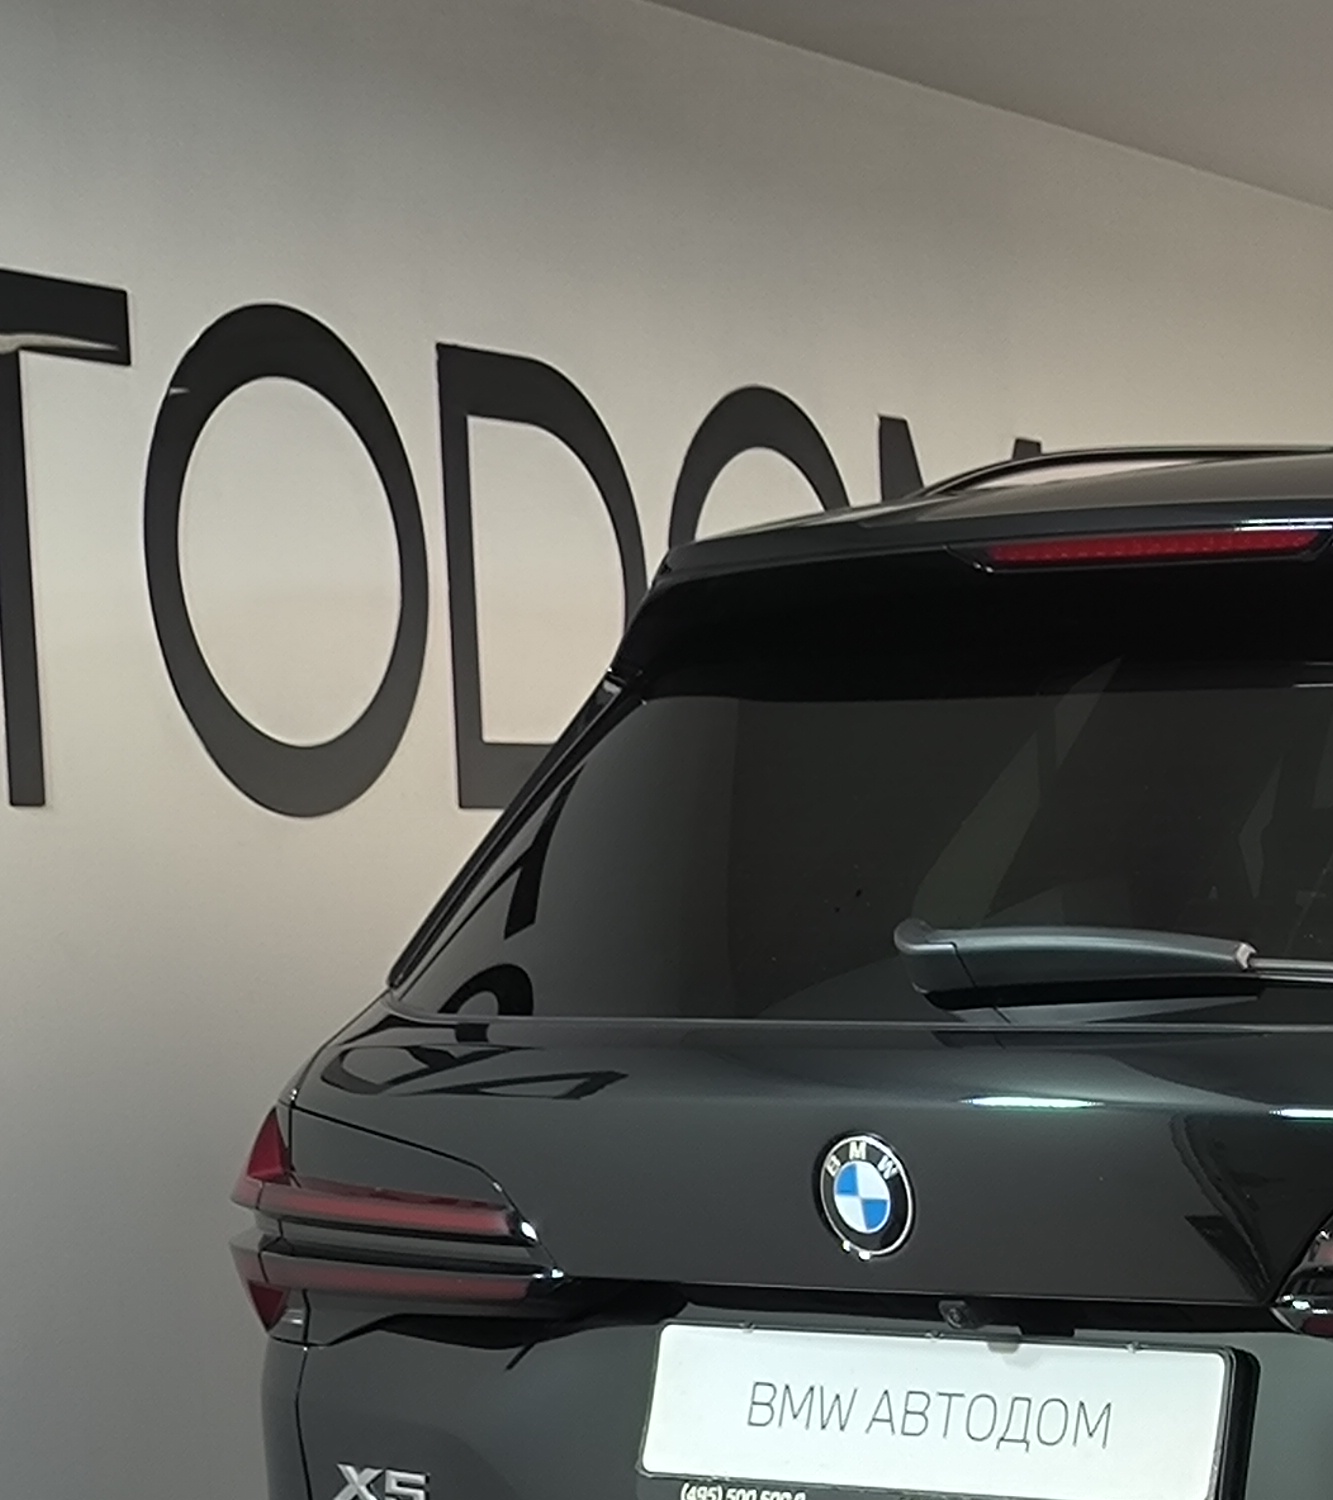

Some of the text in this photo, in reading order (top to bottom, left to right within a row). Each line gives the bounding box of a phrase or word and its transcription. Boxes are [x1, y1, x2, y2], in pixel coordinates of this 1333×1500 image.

[0, 268, 1042, 817] TOD
[825, 1140, 899, 1180] BMW
[747, 1381, 1112, 1452] BMW АВТОДОМ
